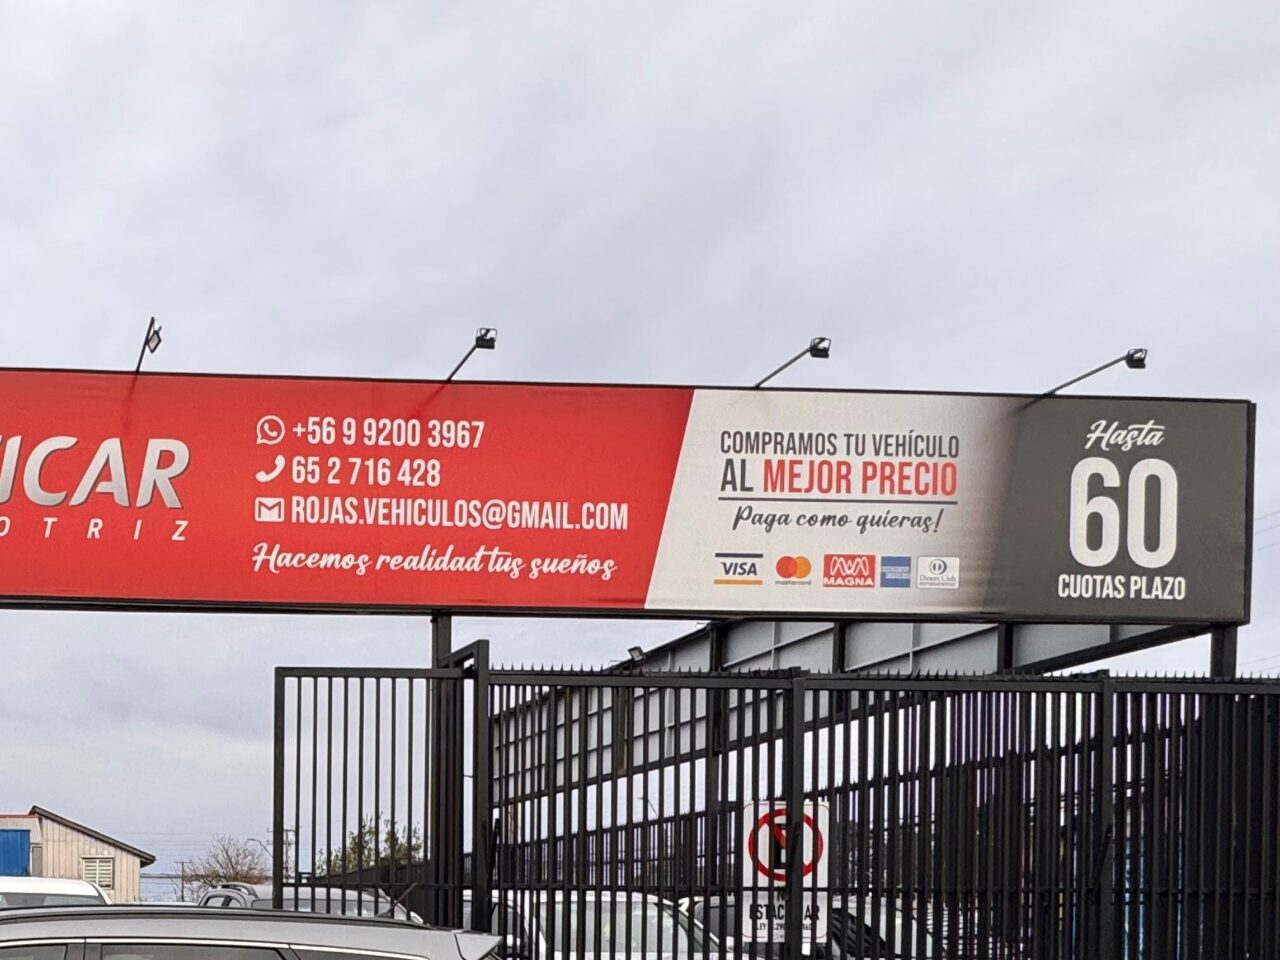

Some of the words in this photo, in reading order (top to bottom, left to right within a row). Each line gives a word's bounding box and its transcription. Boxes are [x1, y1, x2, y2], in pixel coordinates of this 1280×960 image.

[292, 416, 336, 445] +56
[342, 417, 357, 446] 9
[363, 418, 421, 447] 9200
[427, 420, 485, 449] 3967
[720, 431, 838, 457] COMPRAMOS
[843, 433, 867, 457] TU
[872, 429, 960, 458] VEHÍCULO
[1084, 420, 1166, 451] Hasta
[291, 456, 320, 484] 65
[327, 457, 341, 484] 2
[348, 457, 391, 486] 716
[396, 458, 441, 487] 428
[720, 458, 754, 492] AL
[763, 459, 852, 494] MEJOR
[861, 461, 958, 496] PRECIO
[291, 495, 629, 530] ROJAS.VEHICULOS@GMAIL.COM
[732, 505, 793, 534] Paga
[796, 513, 851, 528] como
[856, 508, 945, 534] quieras!
[1069, 456, 1178, 568] 60
[252, 542, 372, 576] Hacemos
[375, 544, 484, 574] realidad
[477, 545, 526, 579] tus
[528, 554, 619, 581] sueños
[720, 561, 758, 576] VISA
[823, 576, 874, 587] MAGNA
[1057, 573, 1126, 599] CUOTAS
[1129, 575, 1186, 600] PLAZO
